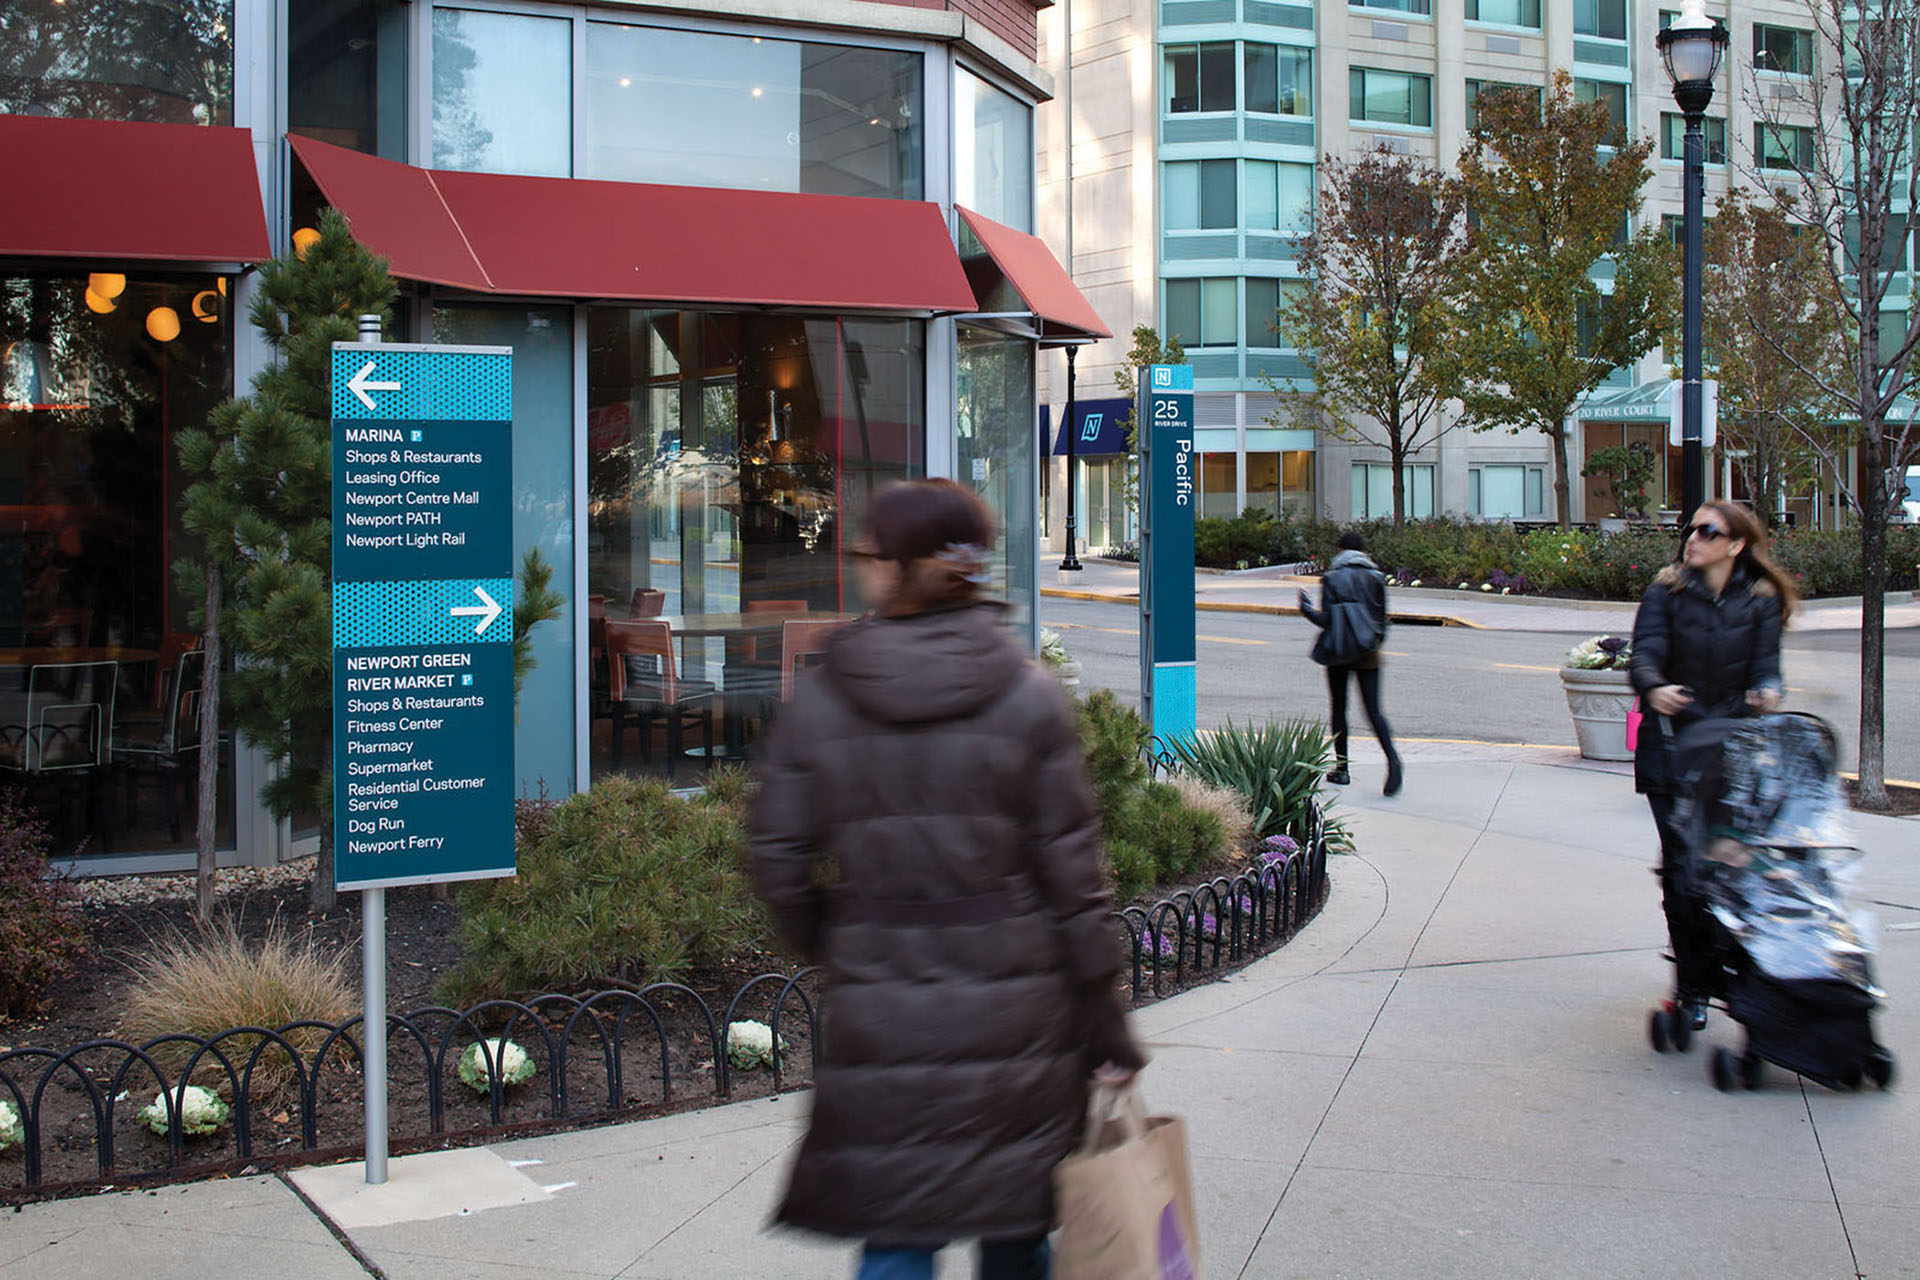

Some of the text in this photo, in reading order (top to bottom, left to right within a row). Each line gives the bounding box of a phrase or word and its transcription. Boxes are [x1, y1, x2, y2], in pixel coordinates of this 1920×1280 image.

[1154, 400, 1178, 418] 25
[1581, 406, 1653, 417] 20 RIVER COURT
[346, 429, 403, 442] MARINA
[346, 450, 482, 464] Shops & Restaurants
[346, 471, 440, 486] Leasing Office
[1176, 440, 1192, 506] Pacific
[346, 491, 479, 506] Newport Centre Mall
[346, 512, 441, 527] Newport PATH
[346, 532, 465, 548] Newport Light Rail
[347, 654, 471, 670] NEWPORT GREEN
[347, 677, 391, 691] RIVER
[395, 675, 454, 689] MARKET
[348, 696, 484, 714] Shops & Restaurants
[348, 718, 444, 733] Fitness Center
[348, 741, 414, 754] Pharmacy
[348, 759, 433, 776] Supermarket
[348, 777, 485, 796] Residential Customer
[349, 798, 399, 812] Service
[349, 818, 404, 834] Dog Run
[349, 836, 444, 854] Newport Ferry
